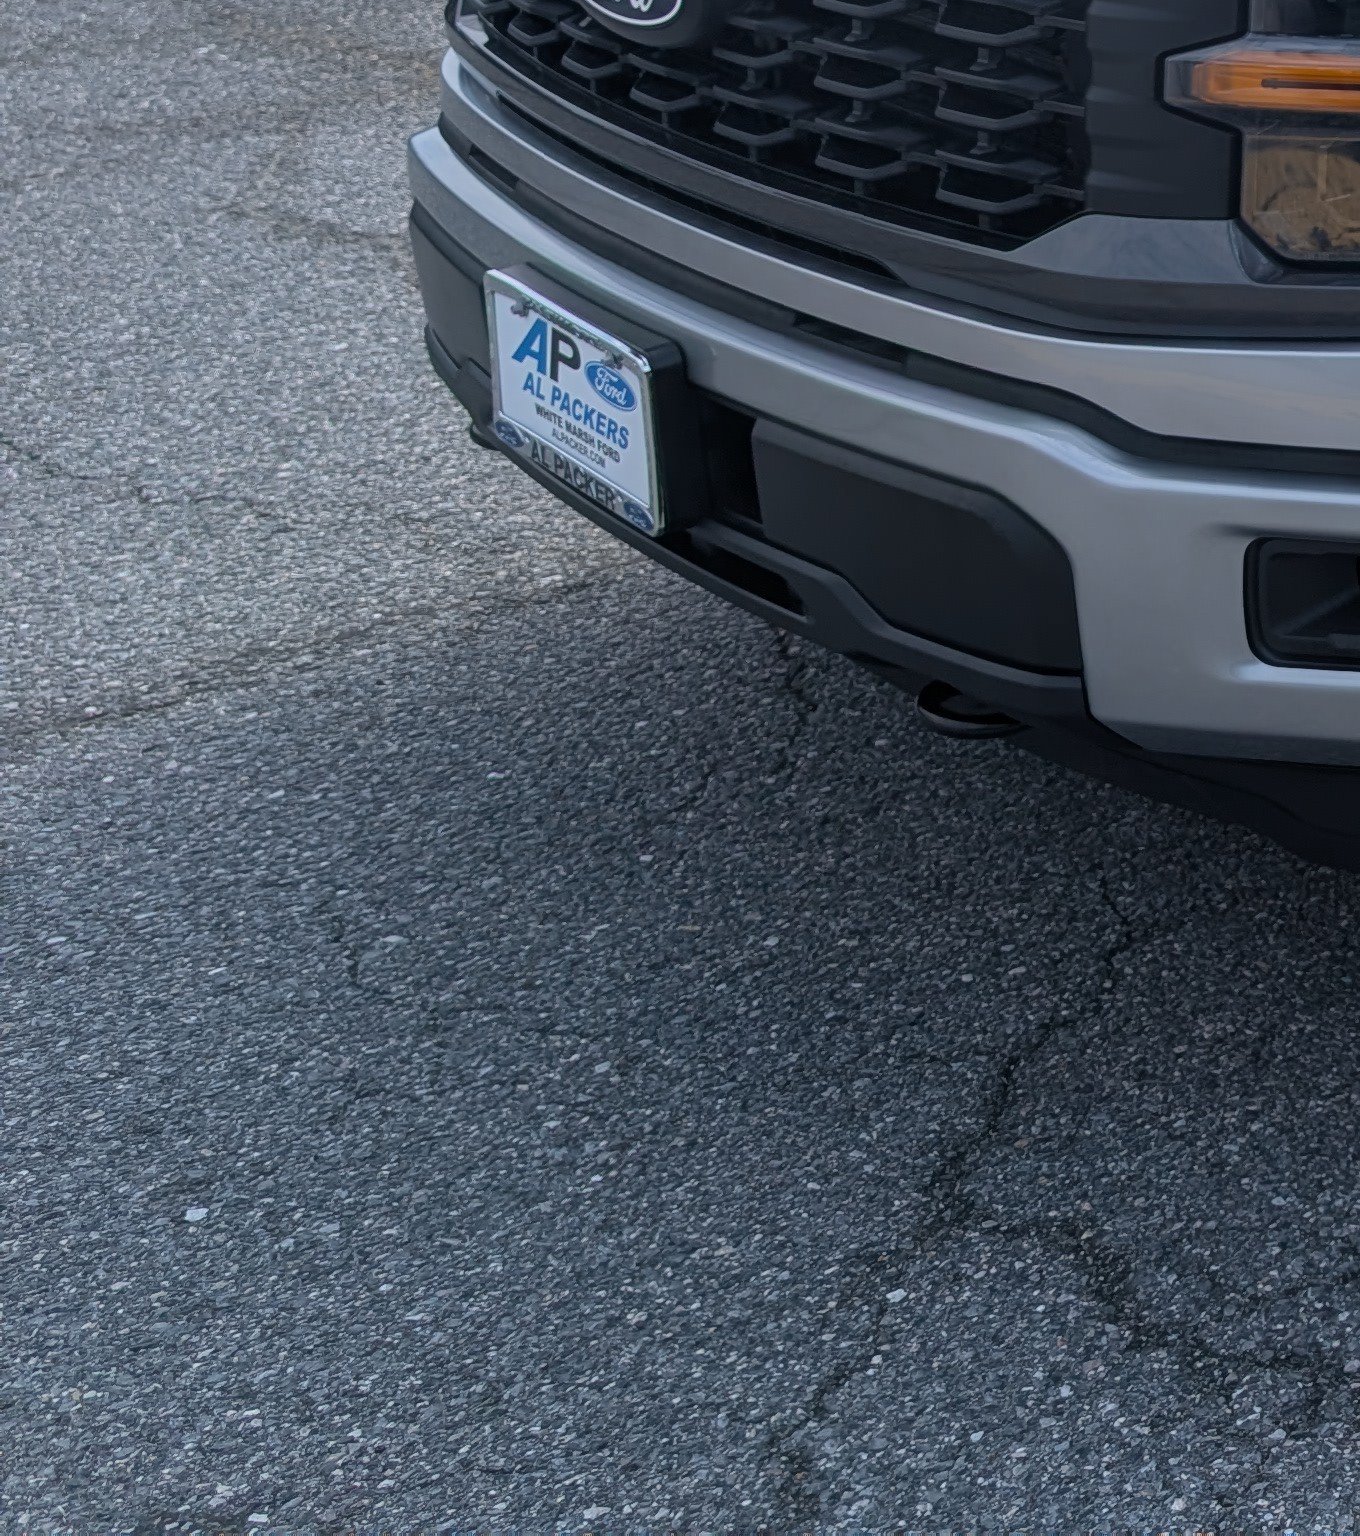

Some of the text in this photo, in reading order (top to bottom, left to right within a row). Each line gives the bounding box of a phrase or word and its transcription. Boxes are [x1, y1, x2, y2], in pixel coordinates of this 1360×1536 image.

[511, 318, 581, 383] AP
[523, 371, 630, 450] AL PACKERS
[594, 366, 628, 406] Ford
[535, 402, 621, 463] WHITE MARSH FORD
[531, 438, 616, 511] AL PACKER
